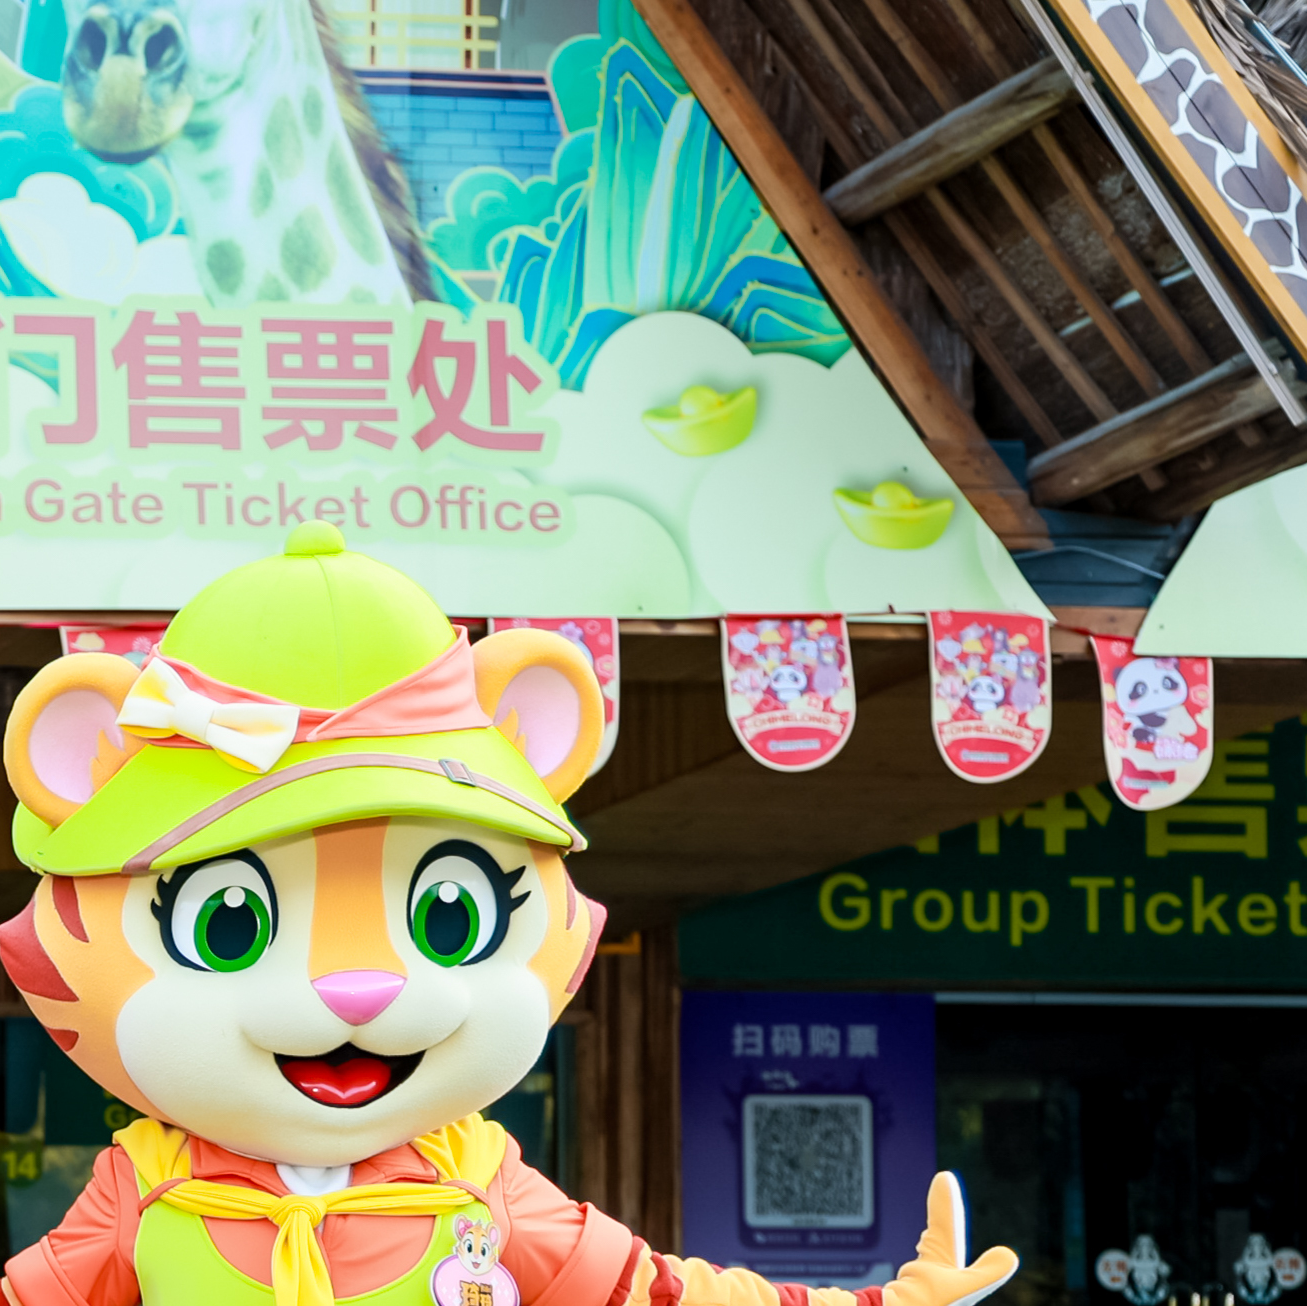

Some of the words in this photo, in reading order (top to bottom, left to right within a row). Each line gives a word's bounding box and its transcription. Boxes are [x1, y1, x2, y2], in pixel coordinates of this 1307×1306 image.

[24, 480, 164, 525] Gate
[182, 481, 371, 529] Ticket
[390, 484, 562, 533] Office
[818, 873, 1050, 946] Group
[1071, 876, 1307, 936] Ticket
[733, 1023, 878, 1058] 扫码购票
[3, 1151, 37, 1180] 14
